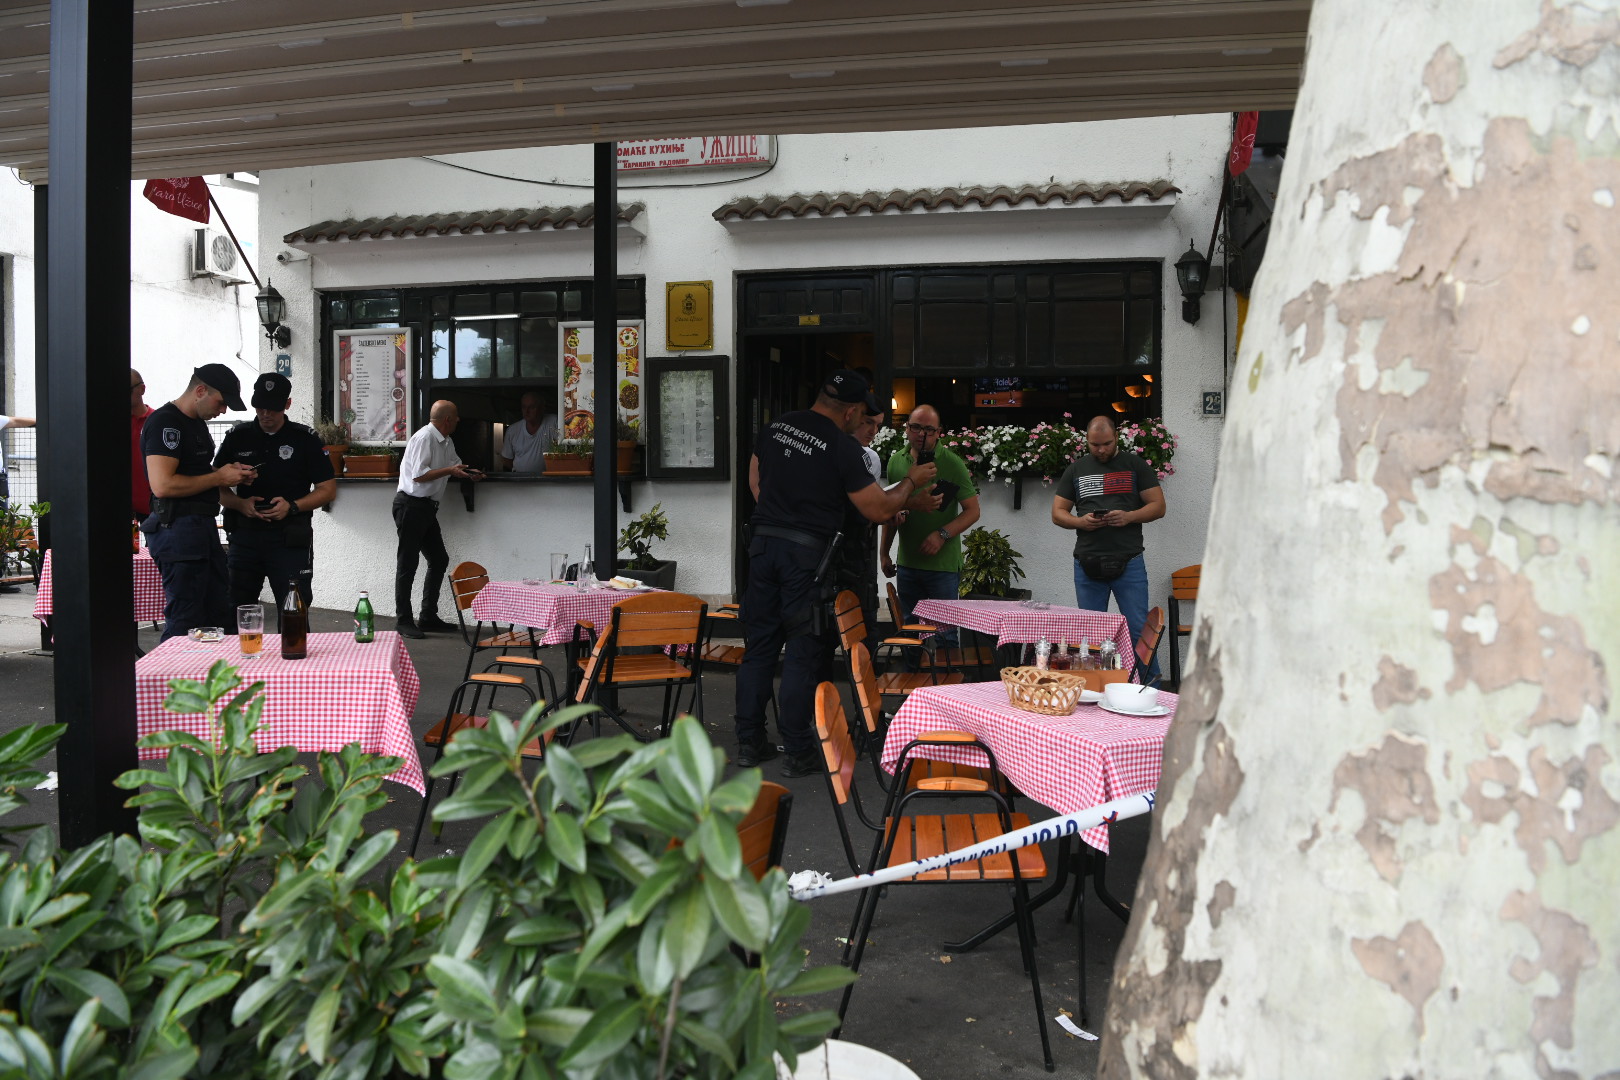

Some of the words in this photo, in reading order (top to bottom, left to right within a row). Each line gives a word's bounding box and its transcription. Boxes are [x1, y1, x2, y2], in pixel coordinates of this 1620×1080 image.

[617, 146, 646, 156] ОМАЋЕ
[649, 144, 685, 154] КУХИЊЕ
[770, 422, 827, 451] ИНТЕРВЕНТНА
[772, 432, 813, 456] ЈЕДИНИЦА
